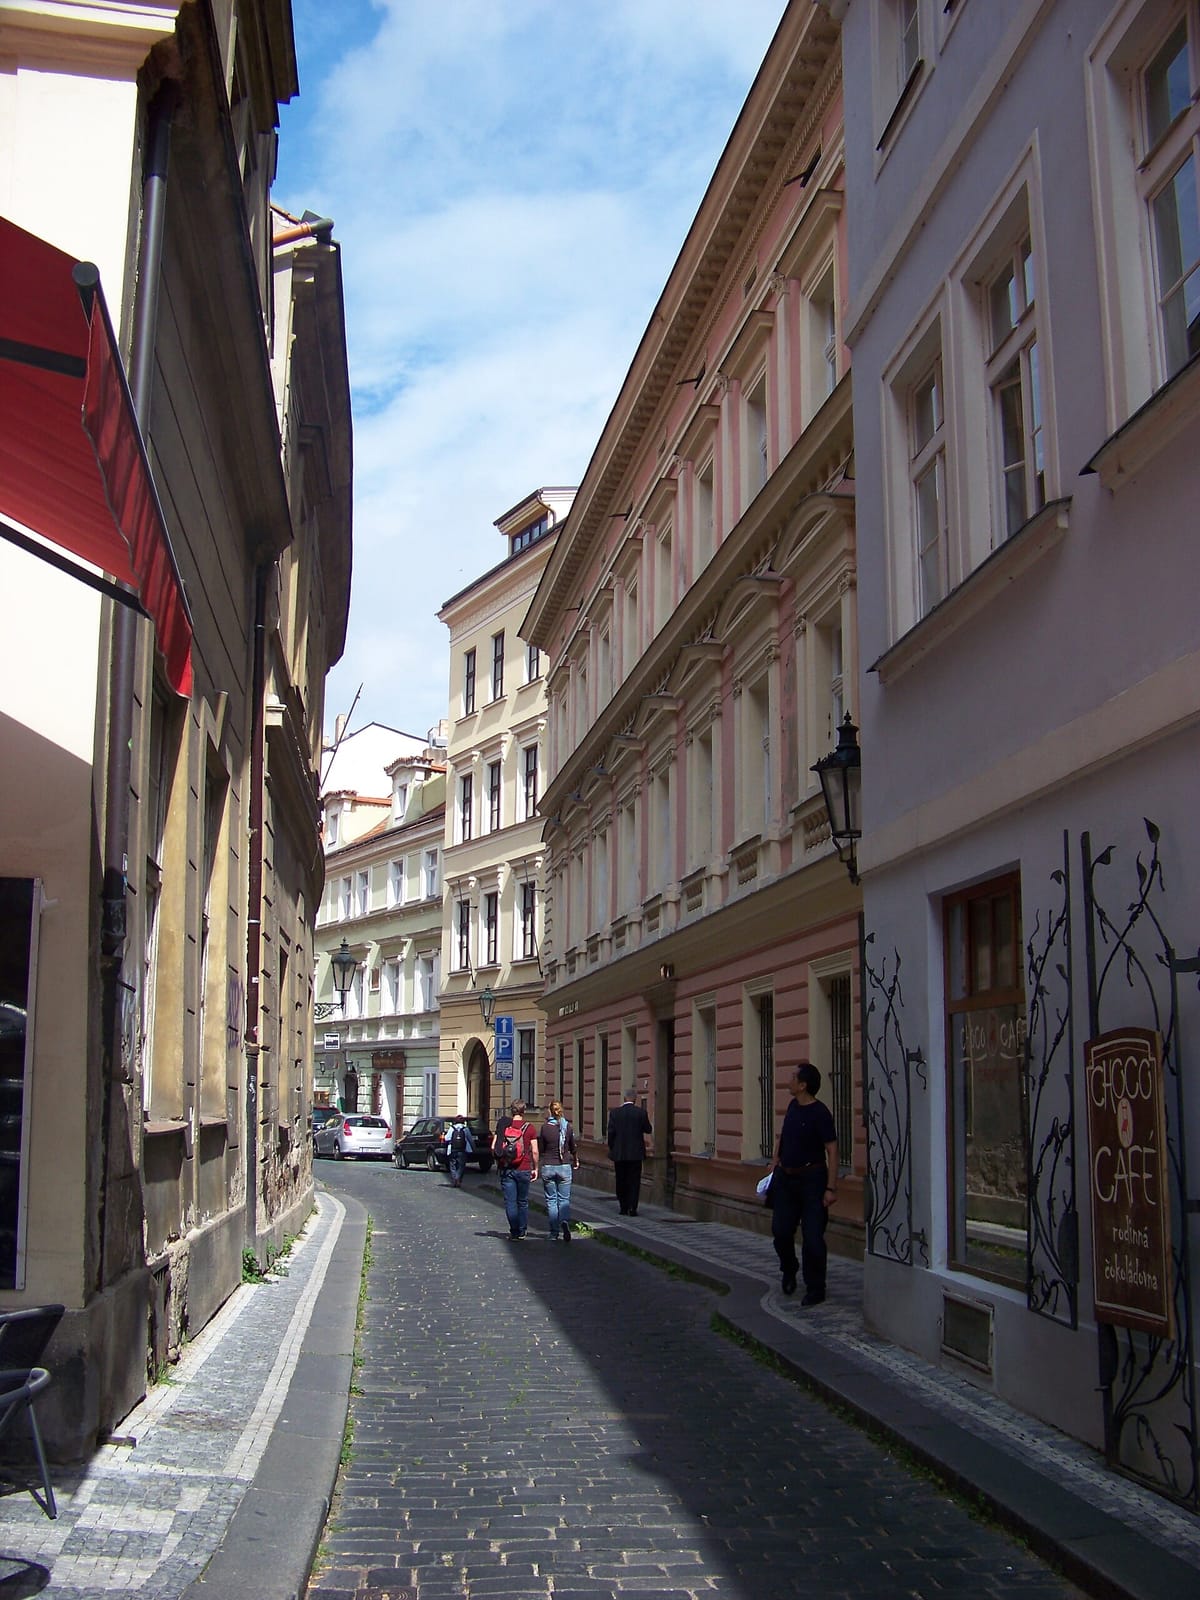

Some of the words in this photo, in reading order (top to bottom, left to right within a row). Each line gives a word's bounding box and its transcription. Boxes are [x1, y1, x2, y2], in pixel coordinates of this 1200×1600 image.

[498, 1038, 510, 1054] P
[1091, 1056, 1152, 1114] CHOCO
[1094, 1131, 1157, 1208] CAFÉ
[1112, 1214, 1149, 1248] rodinná
[1104, 1253, 1158, 1291] čokoládovna
